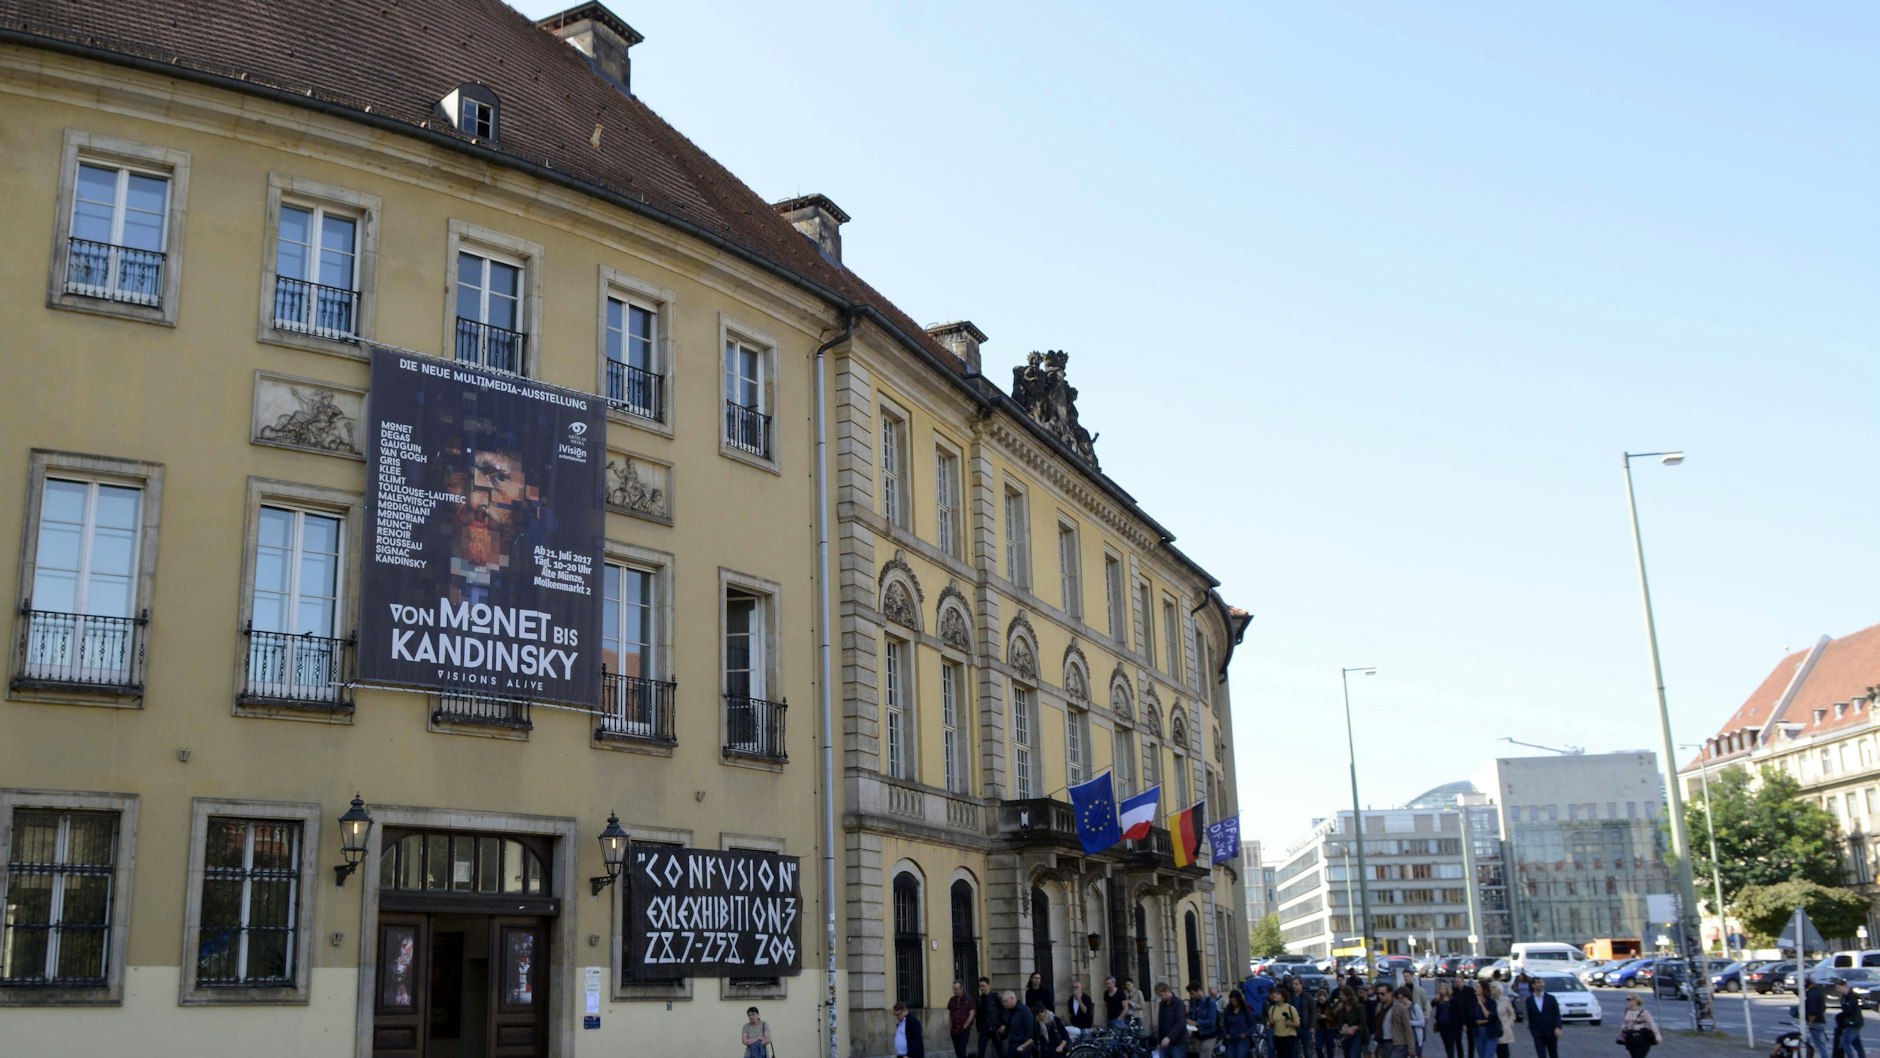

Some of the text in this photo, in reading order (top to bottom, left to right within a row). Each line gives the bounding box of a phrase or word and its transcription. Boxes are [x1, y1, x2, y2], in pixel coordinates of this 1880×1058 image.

[400, 358, 587, 410] DIE NEUE MULTIMEDIA-AUSSTELLUNG
[381, 420, 413, 434] MONET
[381, 430, 411, 442] DEGAS
[380, 439, 422, 454] GAUGUIN
[559, 444, 587, 458] iVision
[379, 456, 401, 467] GRIS
[380, 447, 428, 463] VAN GOGH
[379, 465, 402, 476] KLEE
[379, 473, 406, 485] KLIMT
[378, 482, 466, 505] TOULOUSE-LAUTREC
[378, 492, 436, 508] MALEWITSCH
[378, 500, 430, 517] MODIGLIANI
[377, 518, 412, 531] MUNCH
[378, 509, 425, 525] MONDRIAN
[377, 526, 411, 540] RENOIR
[376, 536, 423, 551] ROUSSEAU
[376, 545, 410, 558] SIGNAC
[375, 554, 427, 569] KANDINSKY
[534, 546, 591, 565] Ab 21. Juli 2017
[534, 555, 551, 567] Tägl.
[578, 564, 592, 574] Uhr
[541, 567, 584, 585] Alte Münze,
[534, 576, 585, 594] Molkenmarkt
[390, 597, 578, 646] VON MONET BIS
[391, 628, 578, 681] KANDINSKY
[437, 670, 543, 691] VISIONS ALIVE
